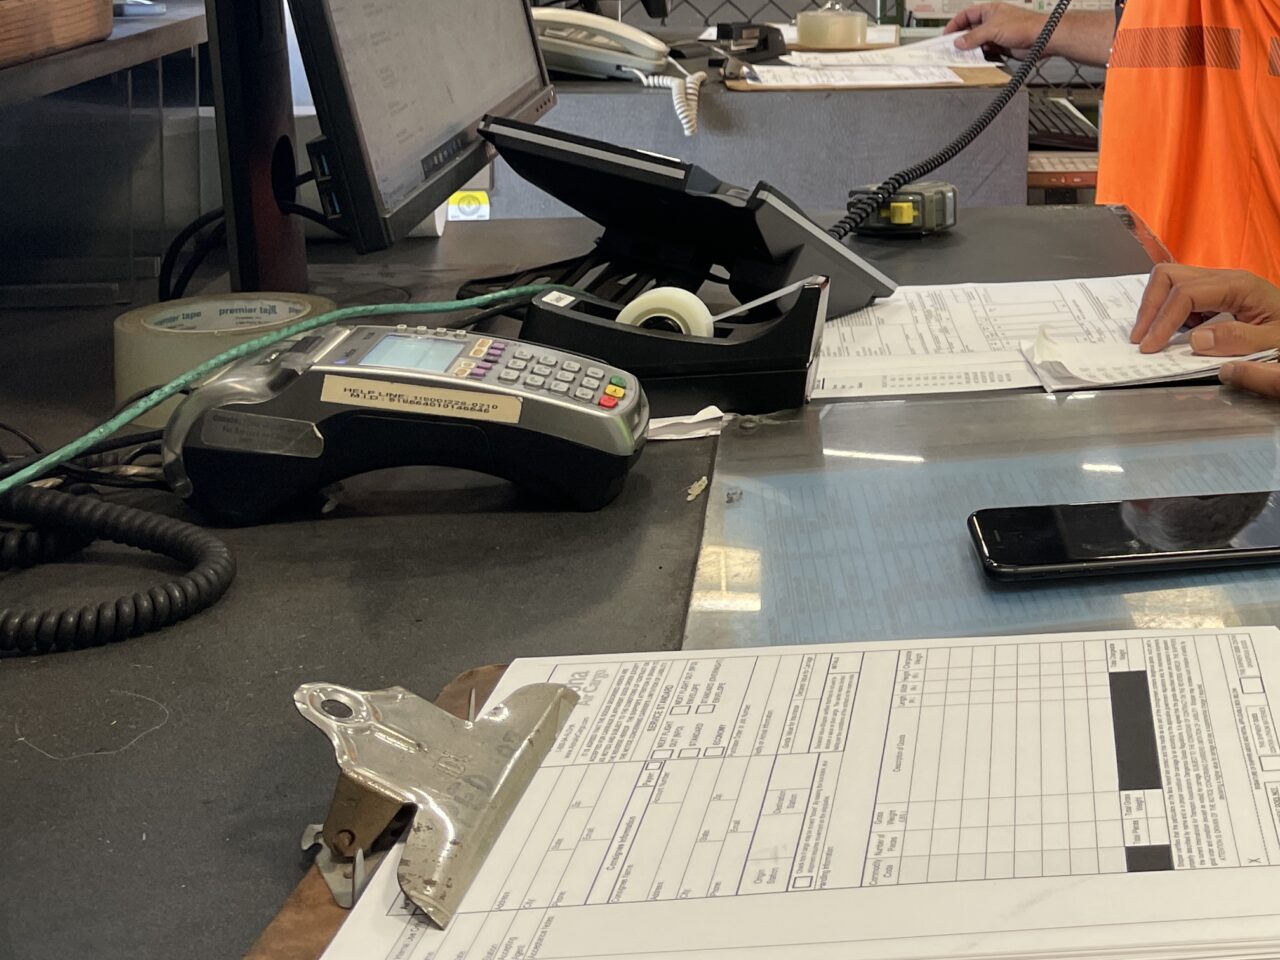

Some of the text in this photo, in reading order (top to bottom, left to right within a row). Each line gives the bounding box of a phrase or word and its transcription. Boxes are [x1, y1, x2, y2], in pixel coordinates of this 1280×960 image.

[154, 310, 202, 326] remier tape
[218, 306, 256, 316] premier
[343, 387, 376, 396] HELP
[574, 669, 611, 706] Air Cargo
[678, 680, 690, 693] FLIGHT
[685, 683, 700, 704] ENVELOPE
[699, 682, 714, 703] STANDARD
[712, 682, 726, 702] ENVELOPE
[673, 694, 684, 704] NEXT
[645, 684, 674, 731] SERVICE STANDARD
[656, 721, 674, 747] NEXT FLIGHT
[668, 738, 679, 746] OUT
[688, 723, 704, 745] STANDARD
[712, 724, 726, 744] ECONOMY
[896, 734, 906, 746] Goods
[892, 751, 904, 772] Description
[651, 772, 670, 802] Account Number
[772, 790, 786, 814] Destination
[786, 793, 798, 808] Station
[1122, 793, 1133, 816] Total Gross
[1134, 796, 1144, 811] Weight
[874, 811, 884, 824] Gross
[885, 809, 898, 824] Weight
[1130, 820, 1141, 844] Total Pieces
[606, 815, 636, 870] Consignee Information
[873, 839, 885, 855] Number
[887, 836, 898, 851] Pieces
[817, 846, 834, 888] Handling Information
[868, 859, 883, 884] Commodity
[883, 864, 894, 878] Code
[611, 864, 634, 902] Consignee Name
[752, 869, 766, 884] Origin
[767, 867, 779, 884] Station
[679, 889, 691, 897] City
[709, 881, 722, 895] Phone
[522, 898, 536, 908] City
[552, 890, 567, 906] Phone
